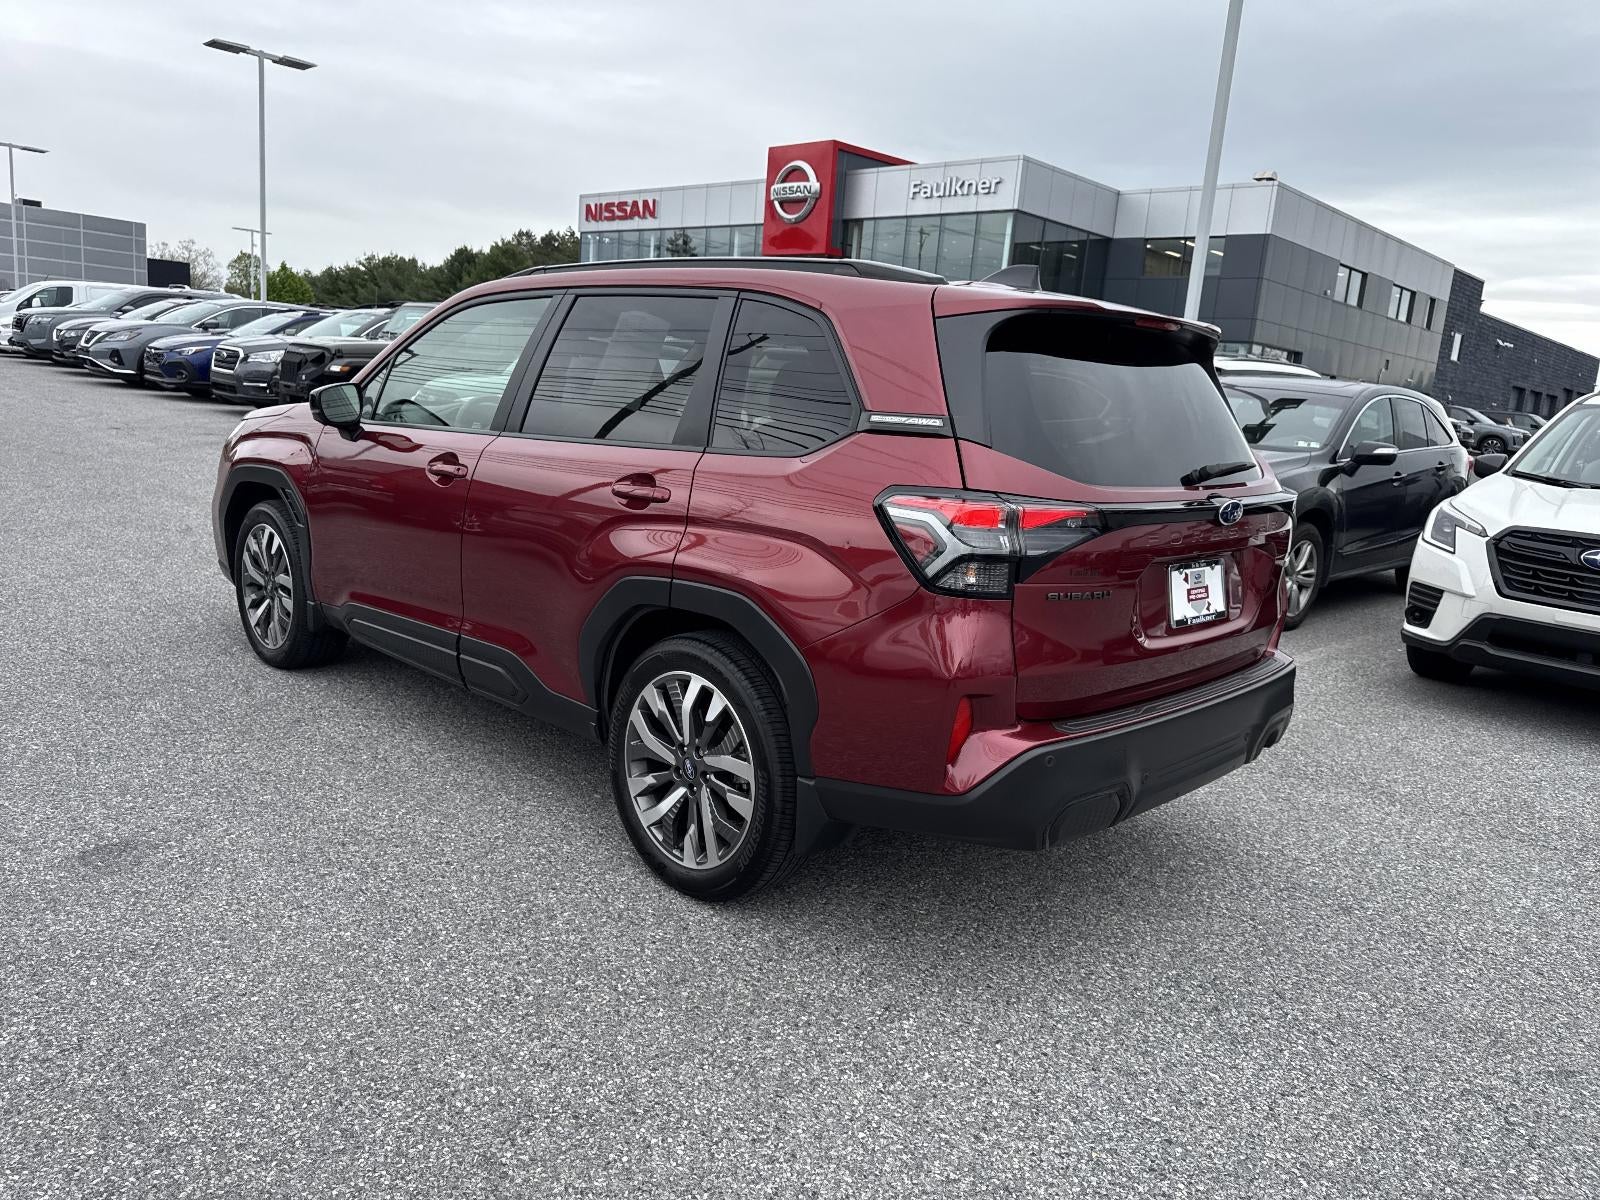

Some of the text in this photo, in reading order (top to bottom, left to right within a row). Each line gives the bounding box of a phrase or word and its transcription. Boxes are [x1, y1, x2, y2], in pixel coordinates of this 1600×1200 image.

[772, 184, 812, 197] NISSAN
[909, 176, 1001, 199] Faulkner
[585, 198, 657, 222] NISSAN
[1187, 614, 1216, 625] Faulkner
